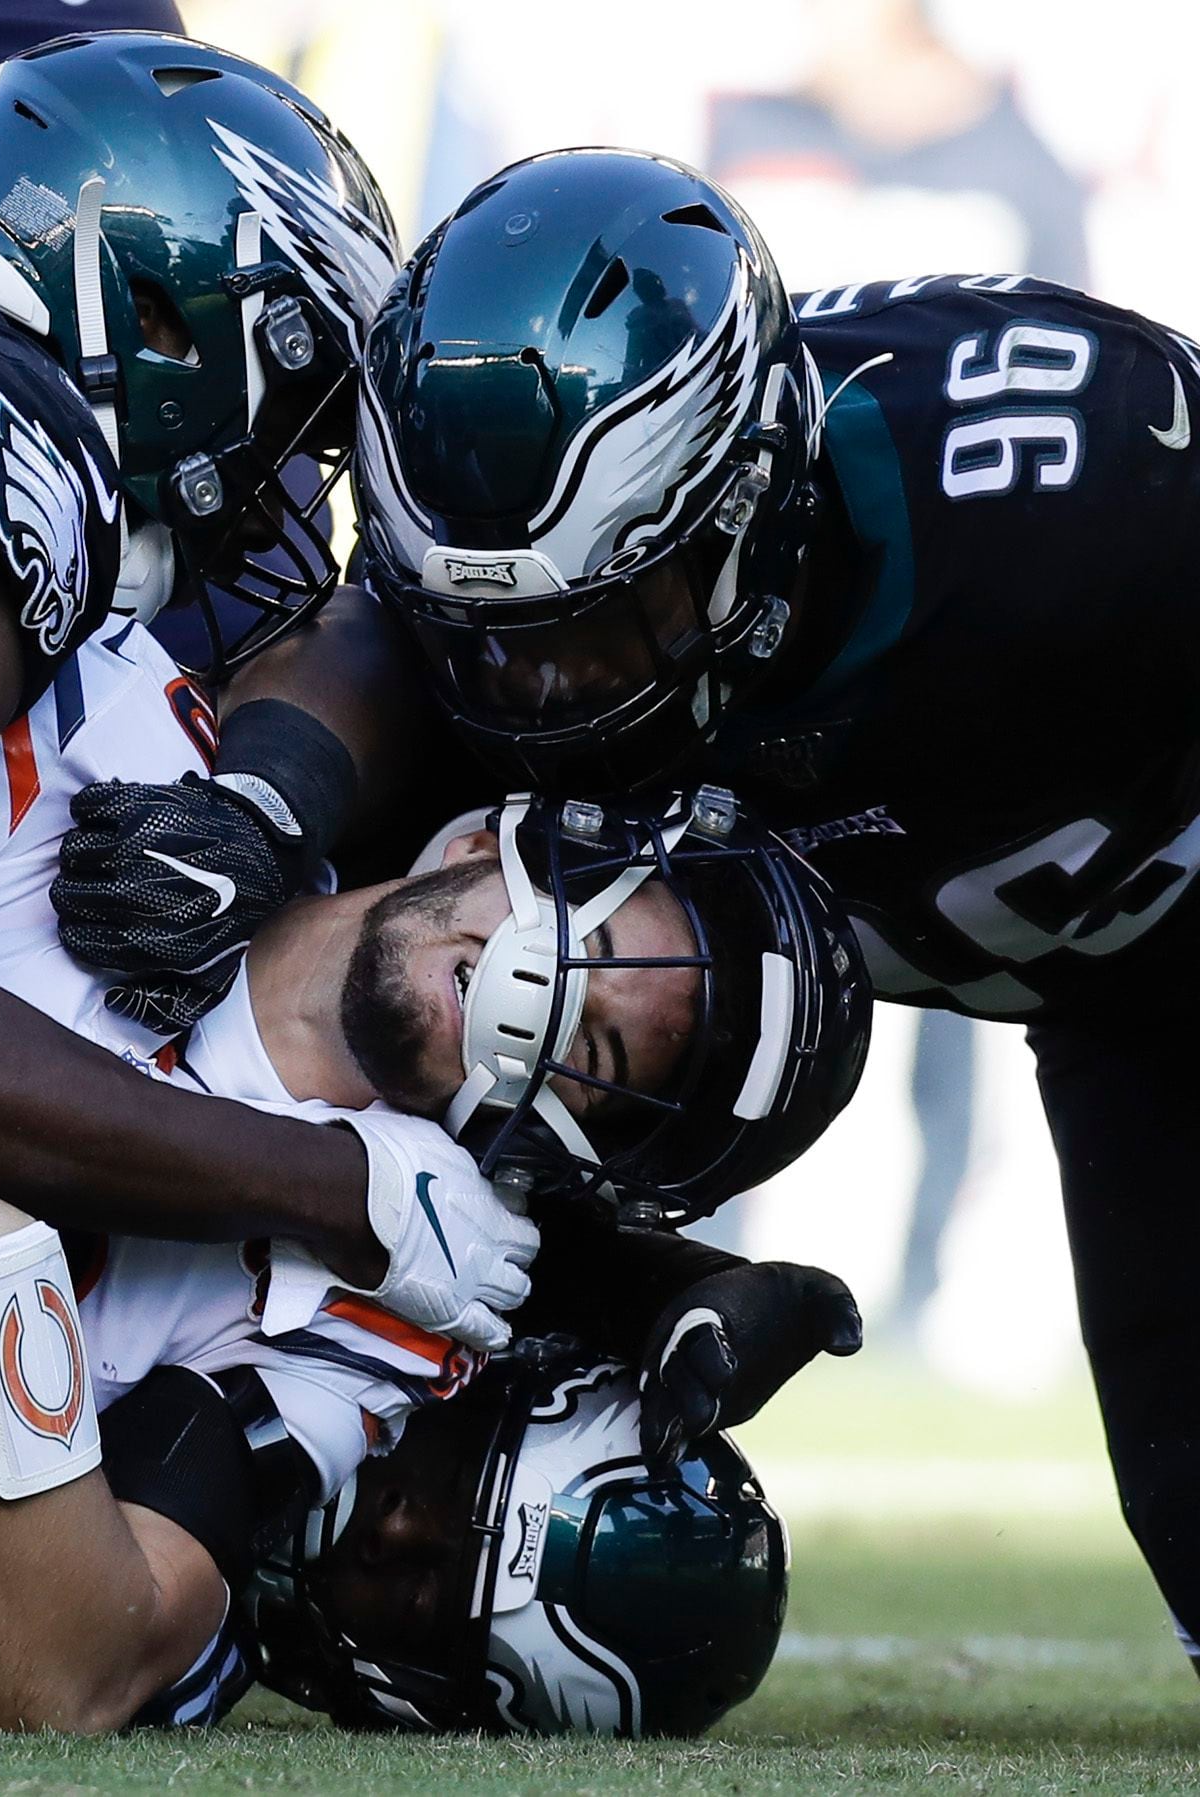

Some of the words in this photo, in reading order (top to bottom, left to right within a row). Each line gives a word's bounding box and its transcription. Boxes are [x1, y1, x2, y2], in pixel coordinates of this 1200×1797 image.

[940, 318, 1099, 501] 96
[444, 559, 518, 587] EAGLES
[508, 1502, 547, 1583] EAGLES
